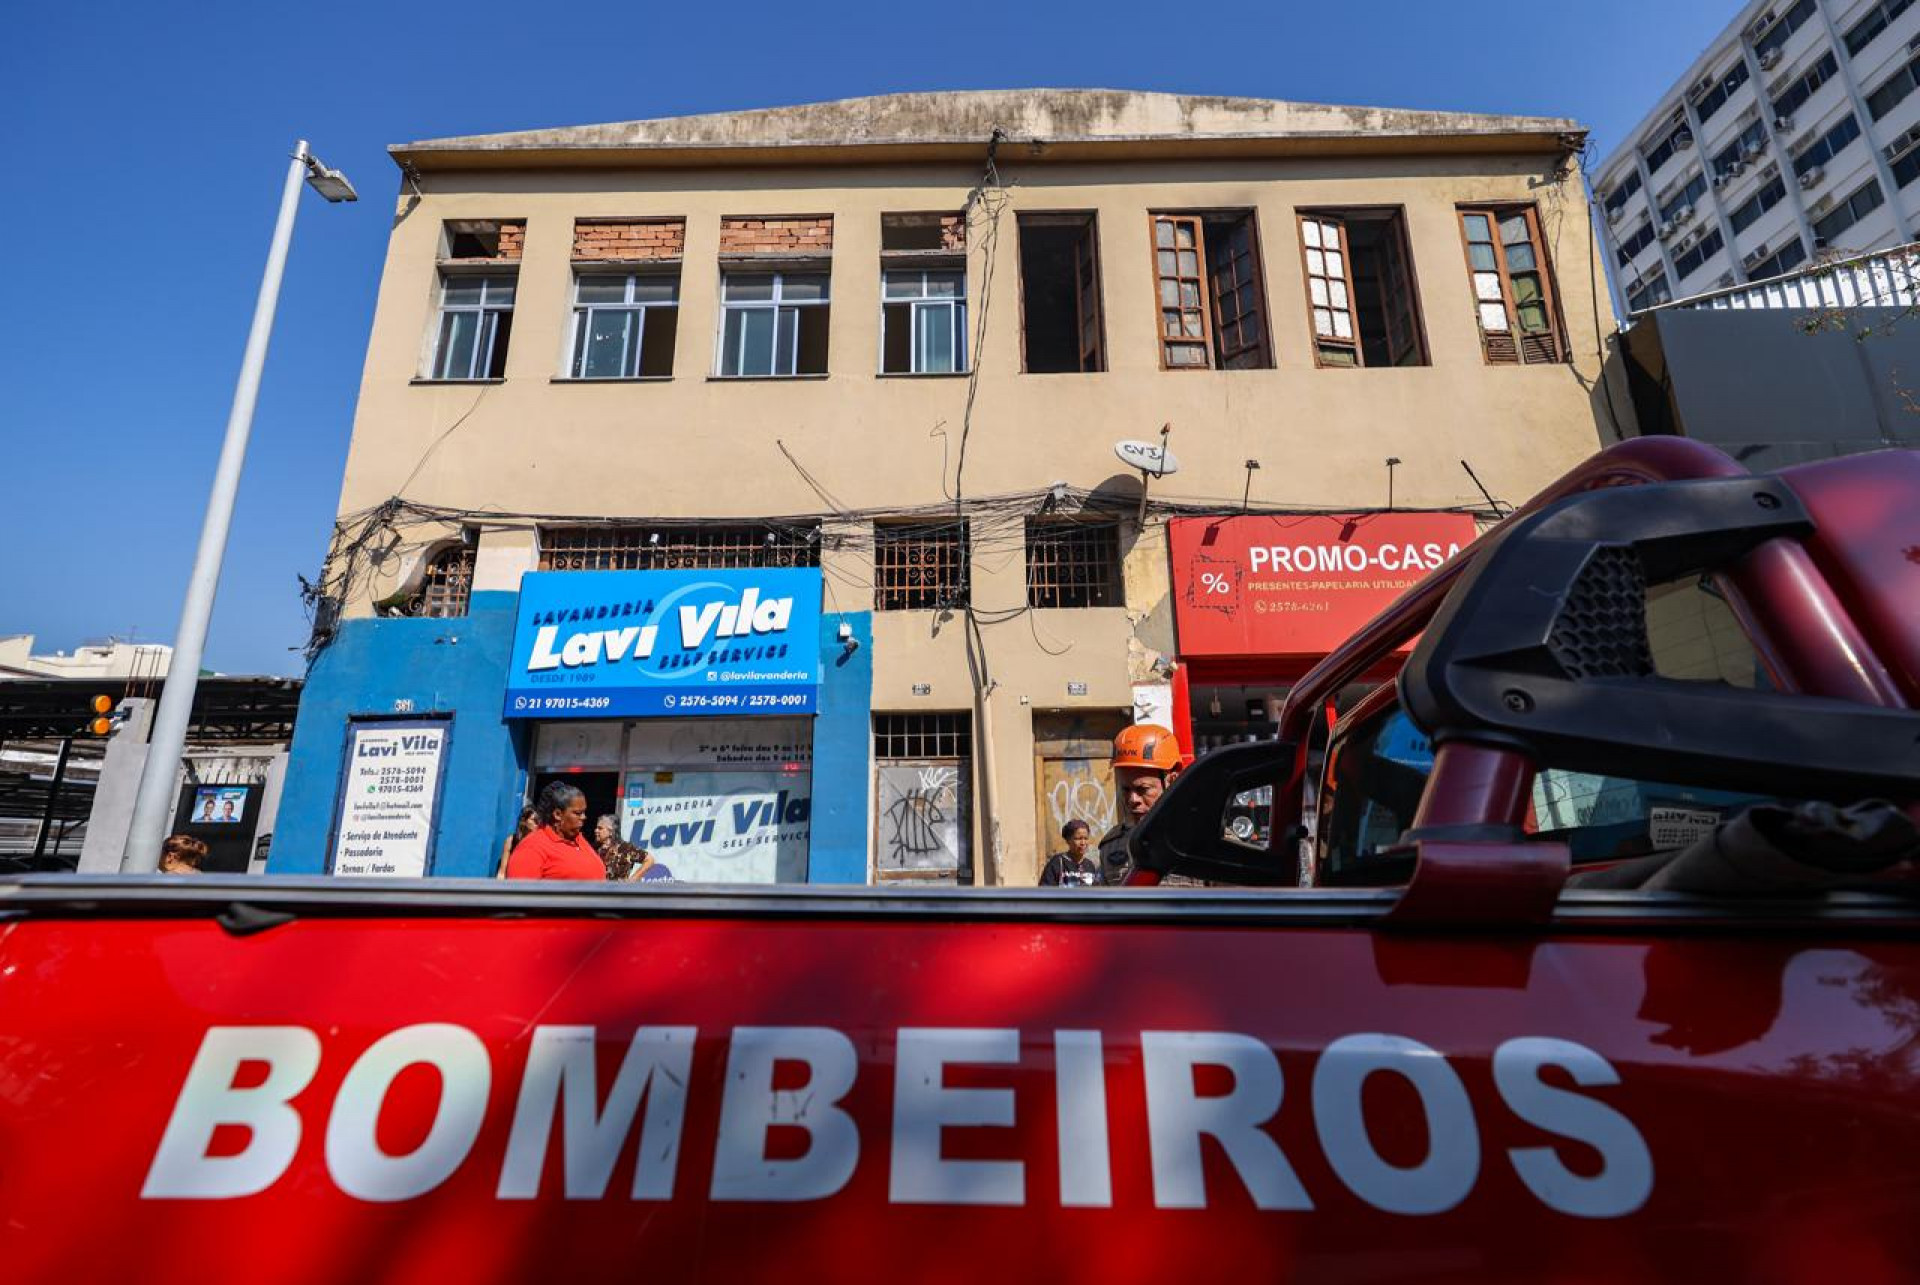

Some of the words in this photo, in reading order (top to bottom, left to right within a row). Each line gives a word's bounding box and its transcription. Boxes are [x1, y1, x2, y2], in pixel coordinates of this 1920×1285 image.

[1248, 581, 1370, 591] PRESENTES-PAPELARIA
[1372, 580, 1417, 589] UTILIDA
[533, 599, 655, 626] LAVANDERIA
[527, 624, 659, 672] Lavi
[678, 587, 794, 649] Vila
[658, 651, 704, 670] SELF
[707, 644, 789, 665] SERVICE
[720, 671, 808, 682] @lavilavanderia
[528, 698, 541, 708] 21
[545, 697, 610, 708] 97015-4369
[680, 695, 739, 706] 2576-5094
[749, 695, 808, 706] 2578-0001
[358, 741, 399, 757] Lavi
[401, 735, 439, 750] Vila
[630, 798, 715, 817] LAVANDERIA
[630, 818, 716, 850] Lavi
[732, 790, 809, 835] Vila
[722, 838, 751, 849] SELF
[139, 1022, 1655, 1218] BOMBEIROS
